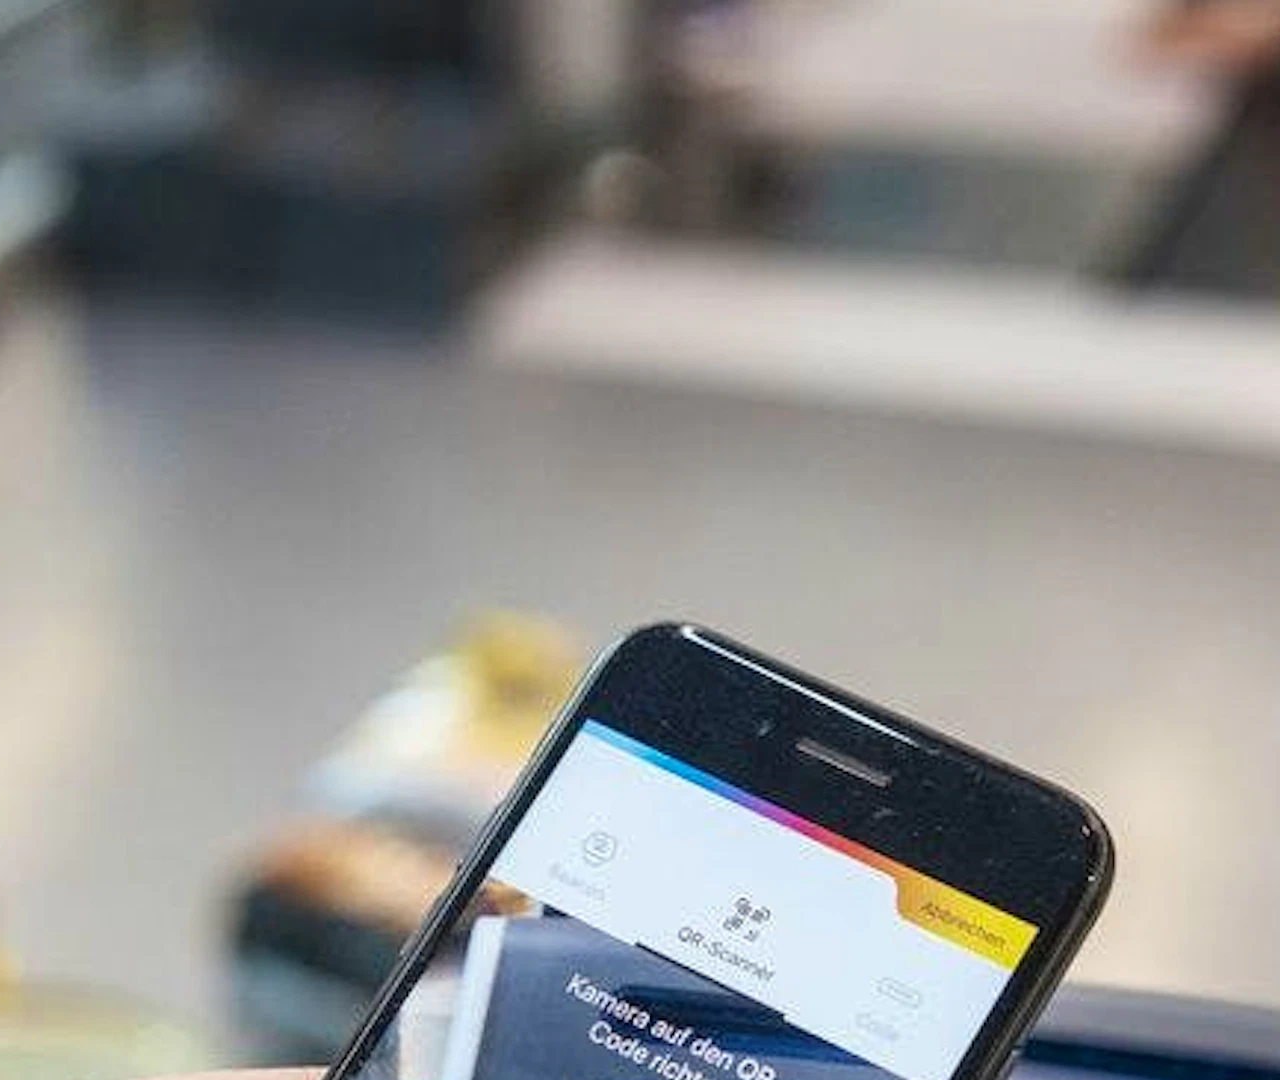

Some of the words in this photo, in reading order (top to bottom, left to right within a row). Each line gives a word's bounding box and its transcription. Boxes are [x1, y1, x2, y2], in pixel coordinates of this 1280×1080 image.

[678, 926, 775, 981] QR-Scanner
[565, 973, 650, 1029] Kamera
[650, 1019, 694, 1048] auf
[689, 1036, 735, 1070] den
[588, 1019, 649, 1064] Code
